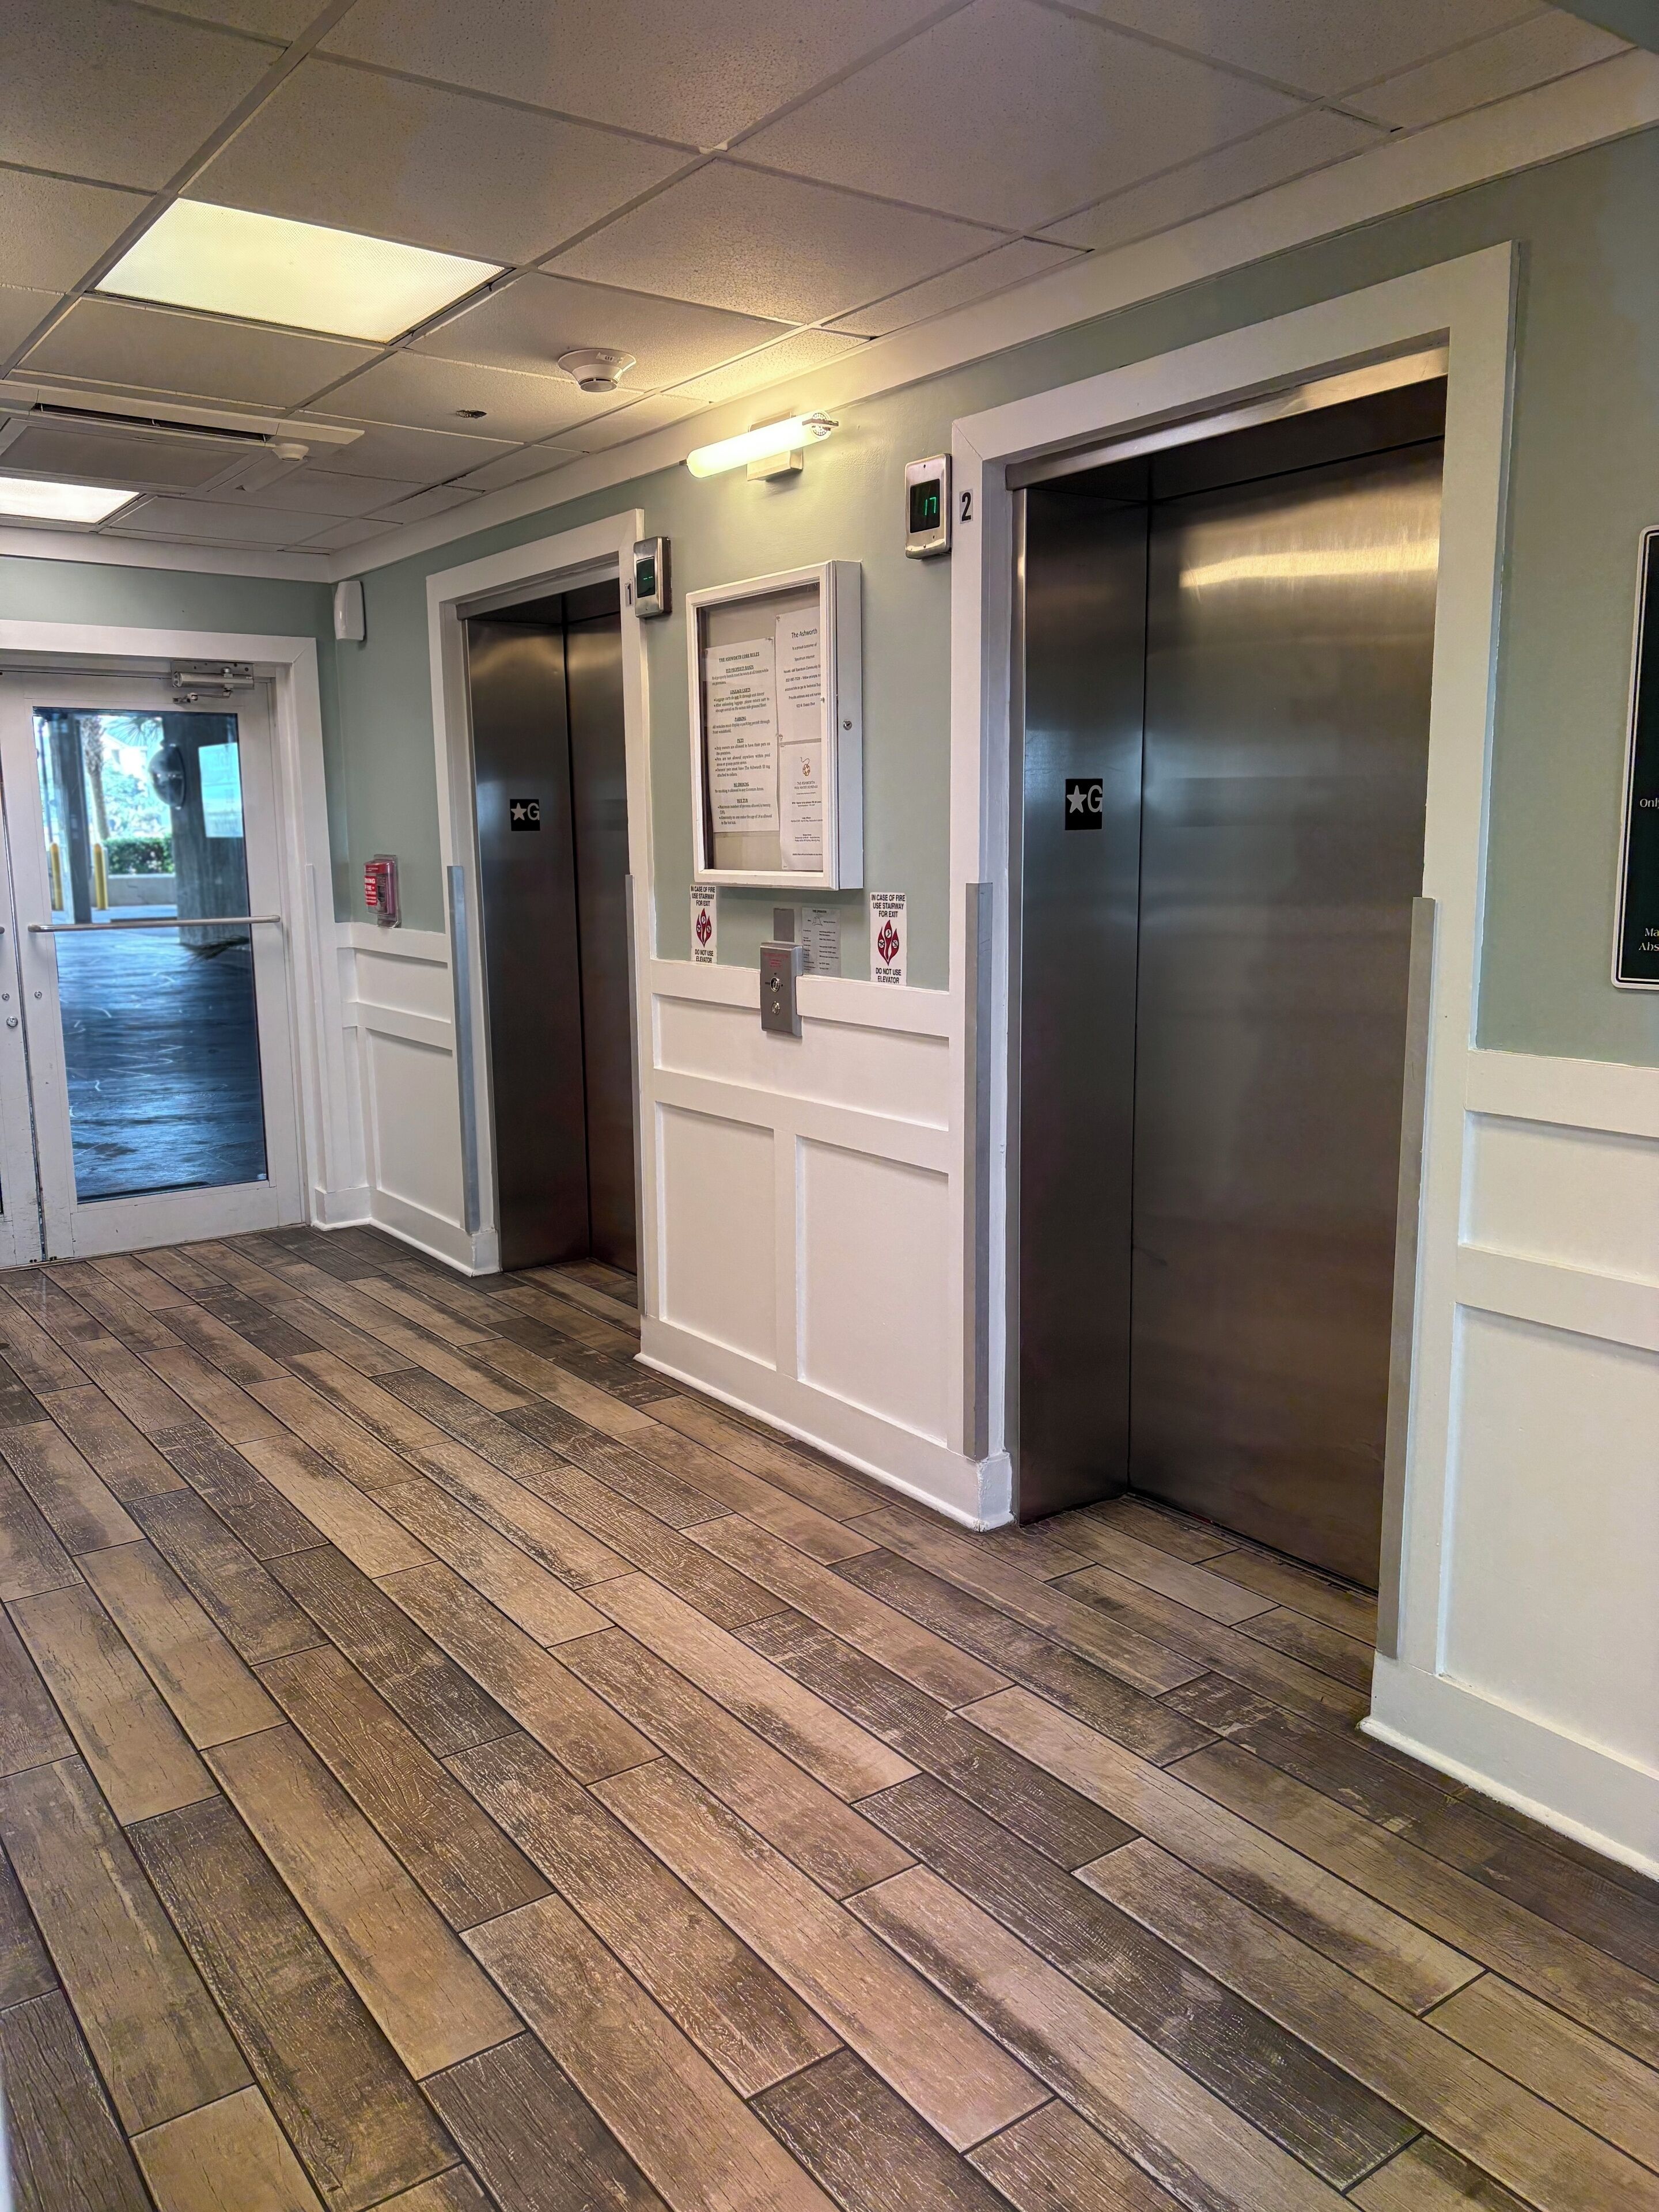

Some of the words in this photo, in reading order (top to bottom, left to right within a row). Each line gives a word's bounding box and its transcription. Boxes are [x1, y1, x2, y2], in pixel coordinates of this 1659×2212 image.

[961, 492, 971, 522] 2
[627, 583, 631, 605] 1
[800, 628, 817, 637] Ashworth
[1088, 785, 1103, 813] G
[527, 802, 540, 821] G
[1638, 942, 1659, 952] Abs
[696, 956, 713, 964] ELEVATOR
[877, 975, 900, 984] ELEVATOR
